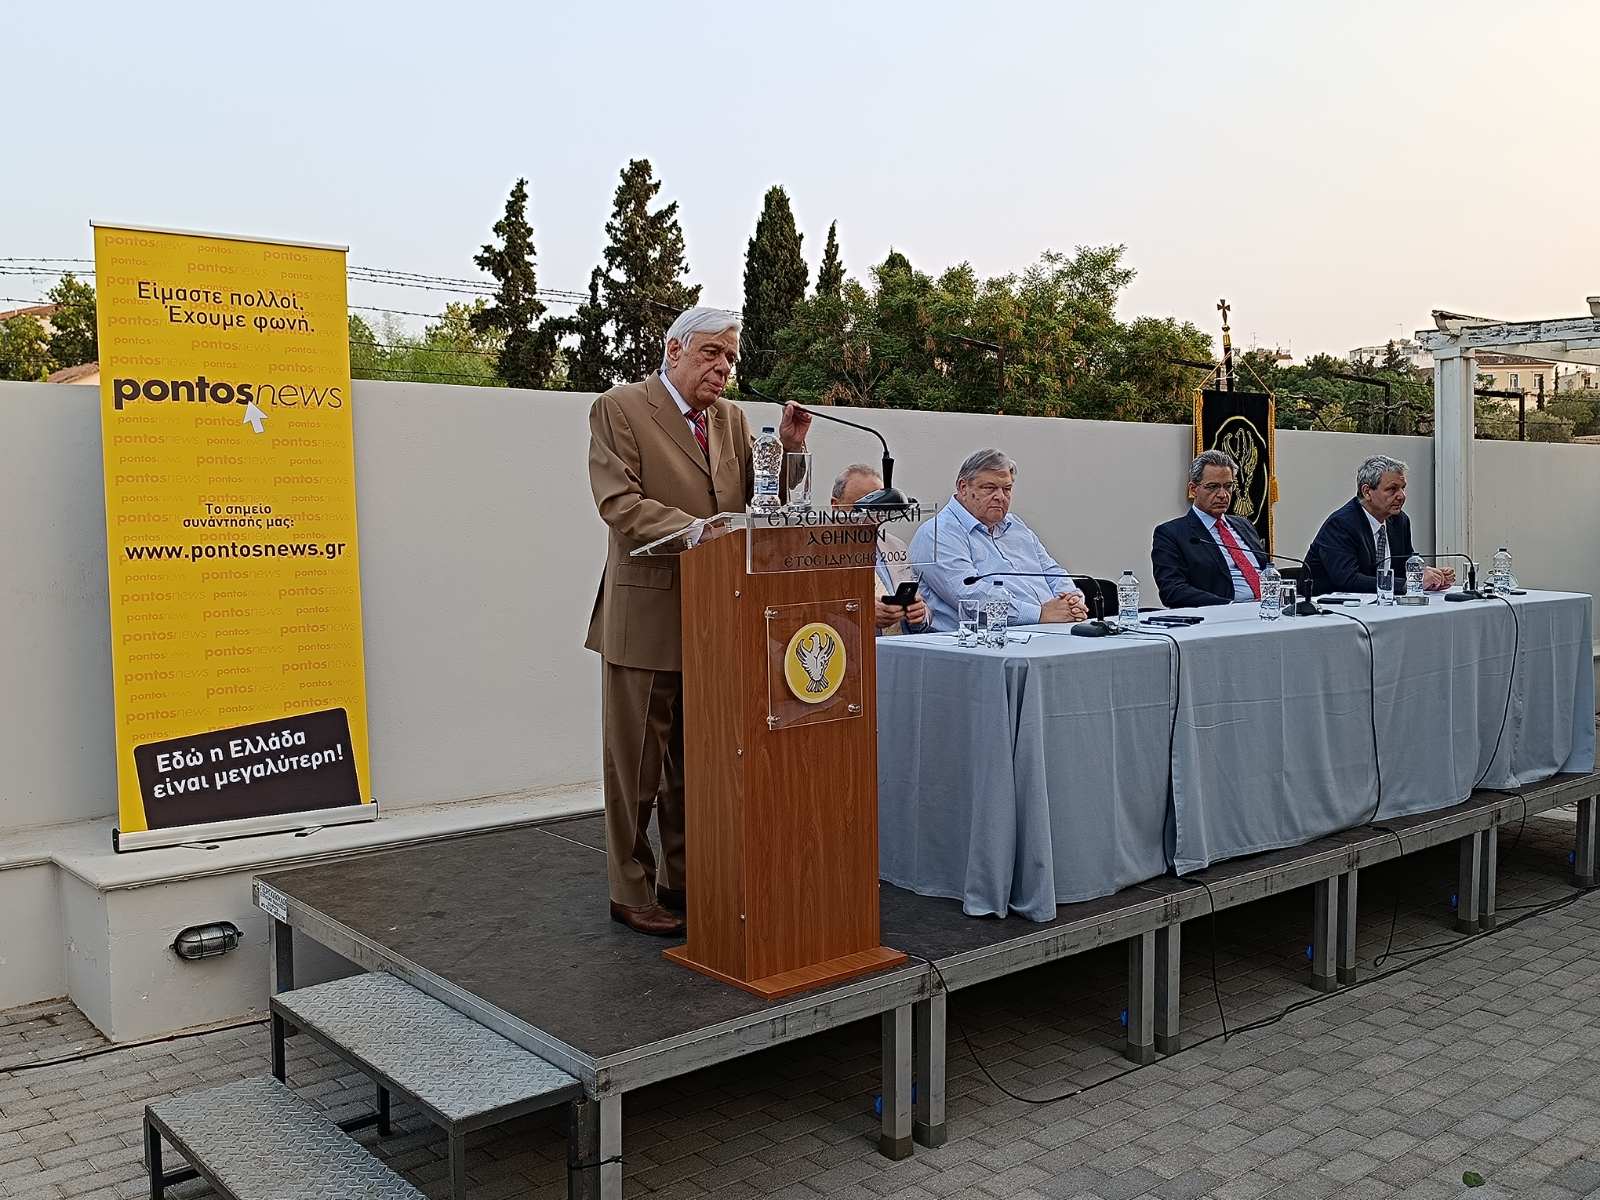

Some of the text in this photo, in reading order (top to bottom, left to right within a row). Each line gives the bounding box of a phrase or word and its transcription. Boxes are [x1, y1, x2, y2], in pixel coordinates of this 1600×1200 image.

[138, 281, 223, 304] Είμαστε
[230, 289, 304, 310] πολλοί.
[164, 305, 315, 333] Έχουμε φωνή.
[113, 376, 342, 410] pontosnews
[183, 516, 294, 529] συνάντησής μας:
[205, 503, 272, 516] Το σημείο
[125, 542, 346, 562] www.pontosnews.gr
[880, 551, 907, 562] 2003
[156, 730, 306, 773] Εδώ η Ελλάδα
[153, 744, 344, 799] είναι μεγαλύτερη!
